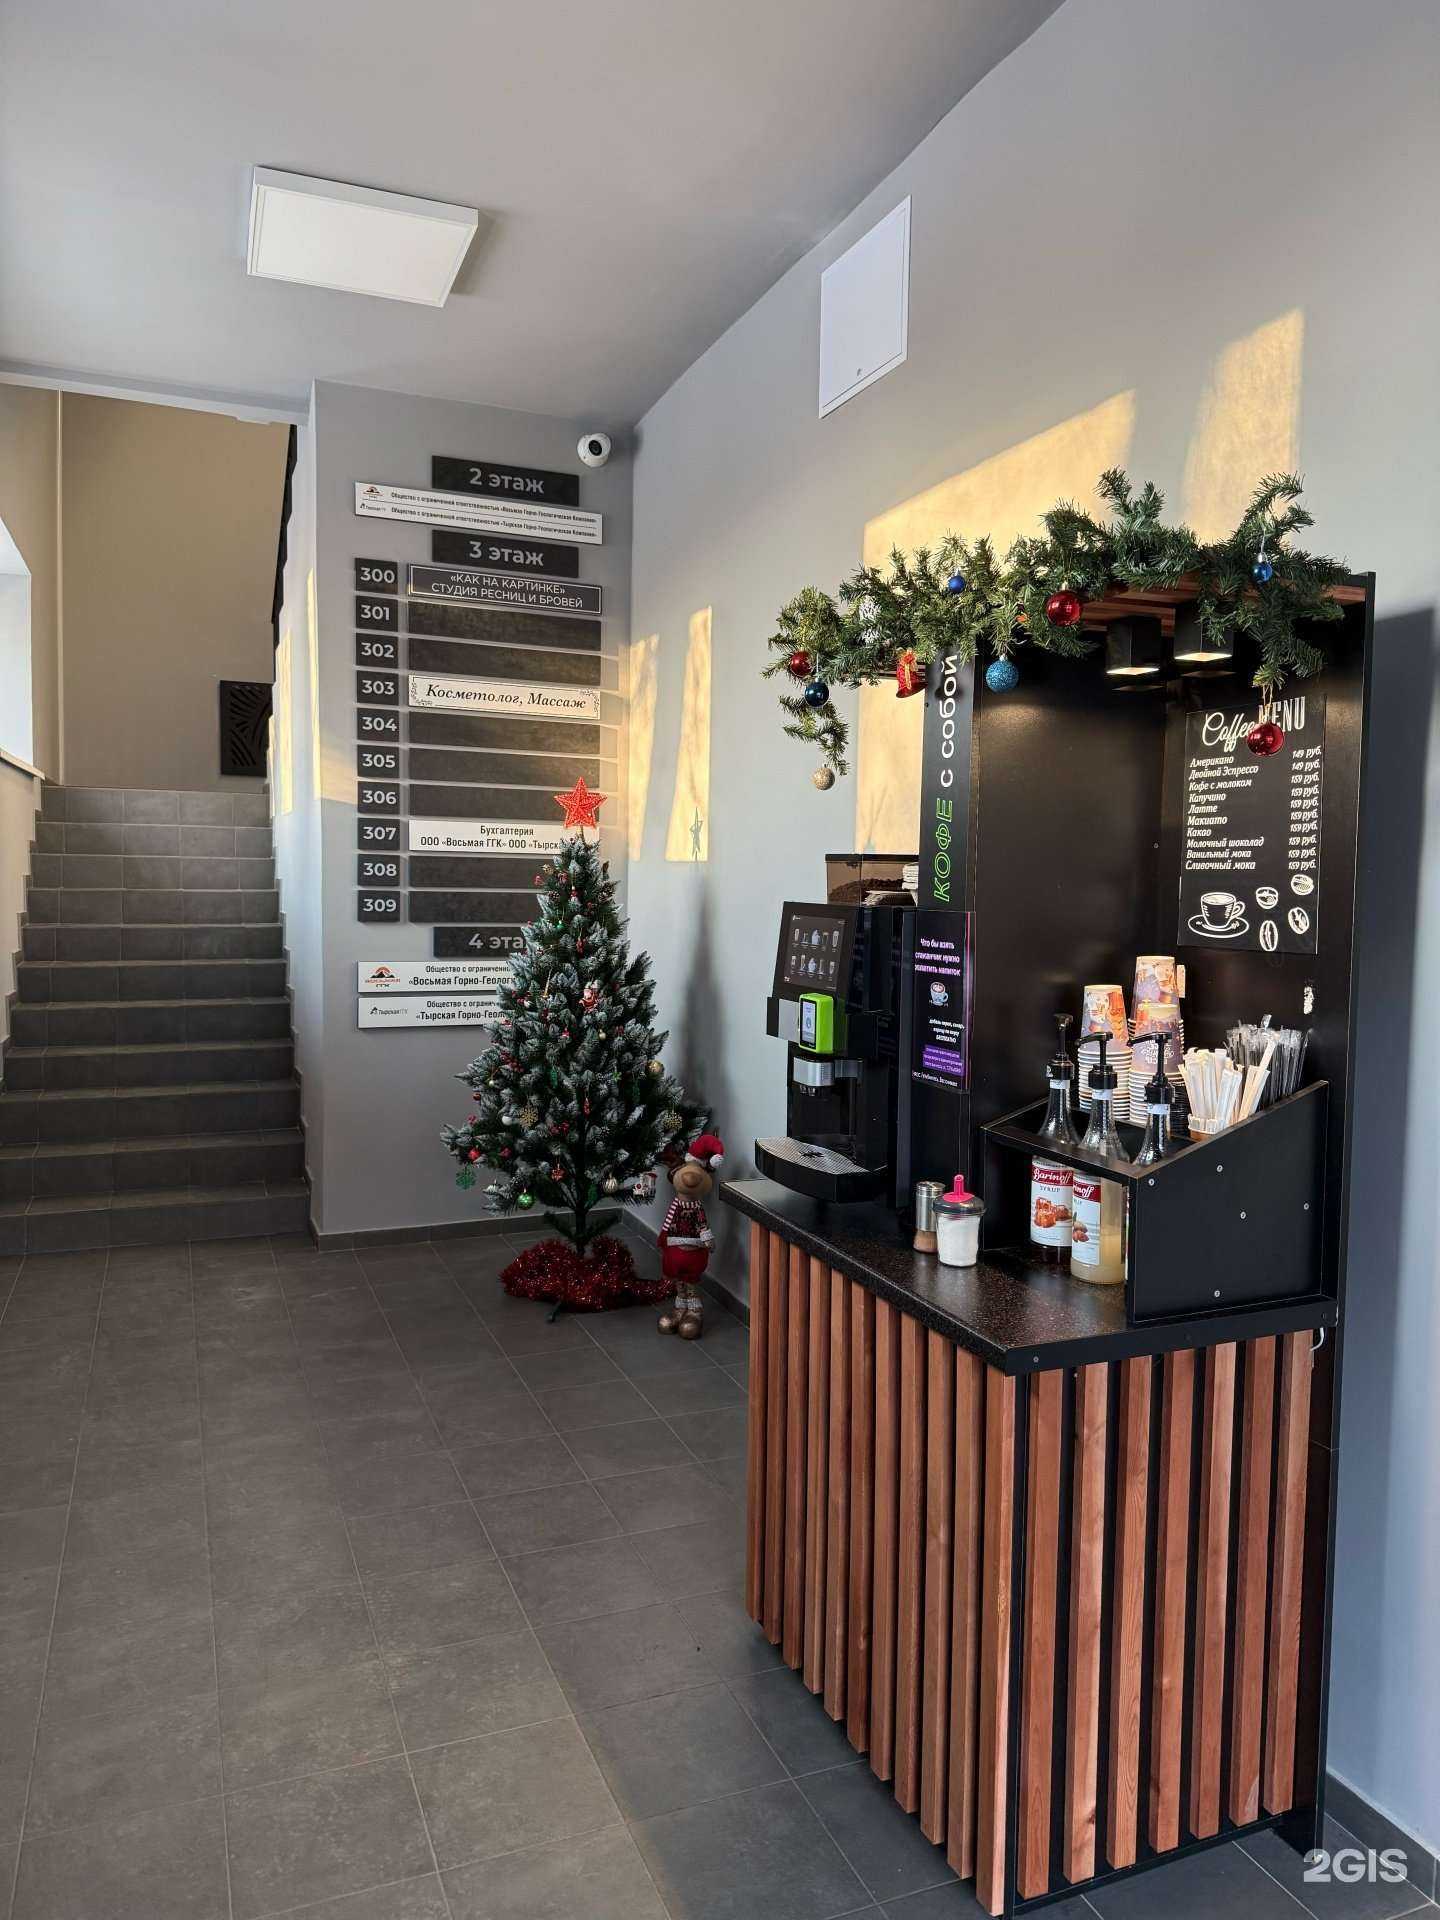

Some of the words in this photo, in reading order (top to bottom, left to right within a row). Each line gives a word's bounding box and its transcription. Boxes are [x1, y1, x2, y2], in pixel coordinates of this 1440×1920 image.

[469, 467, 482, 486] 2
[488, 472, 545, 494] этаж
[469, 540, 482, 559] 3
[488, 546, 544, 567] этаж
[360, 567, 395, 584] 300
[450, 573, 480, 585] «КАК
[482, 576, 498, 586] НА
[502, 578, 566, 594] КАРТИНКЕ»
[431, 582, 478, 596] СТУДИЯ
[480, 588, 526, 604] РЕСНИЦ
[528, 592, 536, 603] И
[539, 592, 583, 608] БРОВЕЙ
[361, 605, 390, 621] 301
[361, 642, 395, 658] 302
[361, 679, 395, 696] 303
[426, 683, 523, 705] Косметолог,
[527, 692, 586, 710] Массаж
[939, 655, 958, 759] собой
[362, 716, 398, 732] 304
[1202, 712, 1257, 752] Coffee
[362, 753, 396, 768] 305
[1190, 756, 1234, 768] Американо
[1306, 746, 1322, 758] руб.
[1188, 766, 1222, 781] Двойной
[1222, 765, 1259, 778] Эспрессо
[1304, 758, 1320, 772] руб.
[940, 769, 954, 788] с
[1188, 781, 1208, 793] Кофе
[1216, 778, 1252, 790] молоком
[1290, 775, 1302, 784] 159
[1304, 772, 1320, 785] руб.
[362, 790, 397, 805] 306
[1188, 793, 1226, 804] Капучино
[1290, 788, 1302, 797] 159
[1303, 784, 1320, 798] руб.
[1188, 804, 1218, 814] Латте
[1290, 800, 1302, 808] 159
[1302, 796, 1319, 809] руб.
[1187, 816, 1228, 826] Макиато
[1290, 812, 1302, 820] 159
[1302, 808, 1318, 821] руб.
[362, 826, 397, 842] 307
[480, 825, 534, 837] Бухгалтерия
[1186, 827, 1212, 837] Какао
[1290, 824, 1302, 832] 159
[1302, 820, 1318, 832] руб.
[420, 837, 440, 846] ООО
[442, 837, 484, 848] «Восьмая
[486, 838, 507, 848] ГГК»
[508, 839, 526, 849] ООО
[528, 840, 561, 851] «Тырск
[1186, 838, 1228, 848] Молочный
[1228, 836, 1264, 848] шоколад
[1288, 837, 1300, 846] 159
[1301, 834, 1317, 846] руб.
[934, 798, 953, 902] КОФЕ
[1186, 848, 1230, 859] Ванильный
[1230, 850, 1252, 858] мока
[1288, 850, 1300, 858] 159
[1300, 846, 1316, 858] руб.
[363, 862, 398, 877] 308
[1185, 860, 1232, 870] Сливочный
[1232, 861, 1256, 870] мока
[1288, 861, 1300, 870] 159
[1300, 860, 1316, 870] руб.
[362, 898, 397, 914] 309
[468, 933, 484, 949] 4
[488, 935, 527, 950] эта
[426, 965, 460, 974] Общество
[408, 976, 452, 986] «Восьмая
[426, 1000, 462, 1009] Общество
[416, 1010, 456, 1020] «Тырская
[458, 1009, 505, 1020] Горно-Геол
[1033, 1167, 1072, 1185] Barinoff
[1072, 1183, 1095, 1198] rinoff
